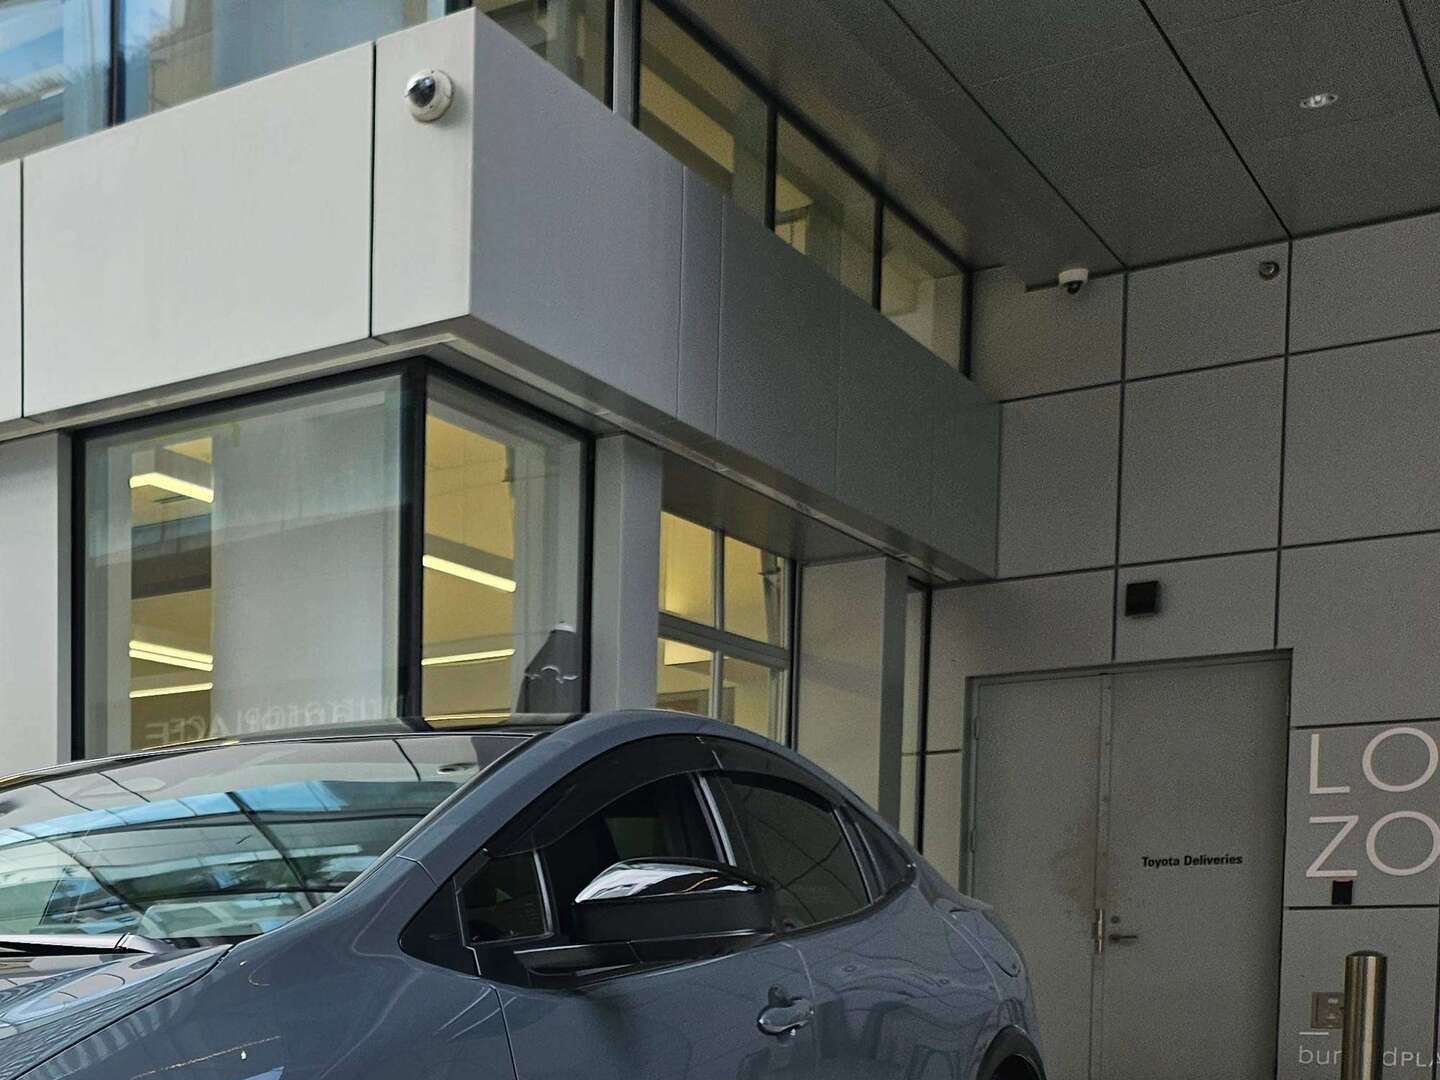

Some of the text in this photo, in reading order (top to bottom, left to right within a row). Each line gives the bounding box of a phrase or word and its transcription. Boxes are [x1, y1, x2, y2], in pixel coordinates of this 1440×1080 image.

[1309, 726, 1439, 795] LO
[1141, 853, 1243, 869] Toyota Deliveries
[1305, 810, 1440, 878] ZO
